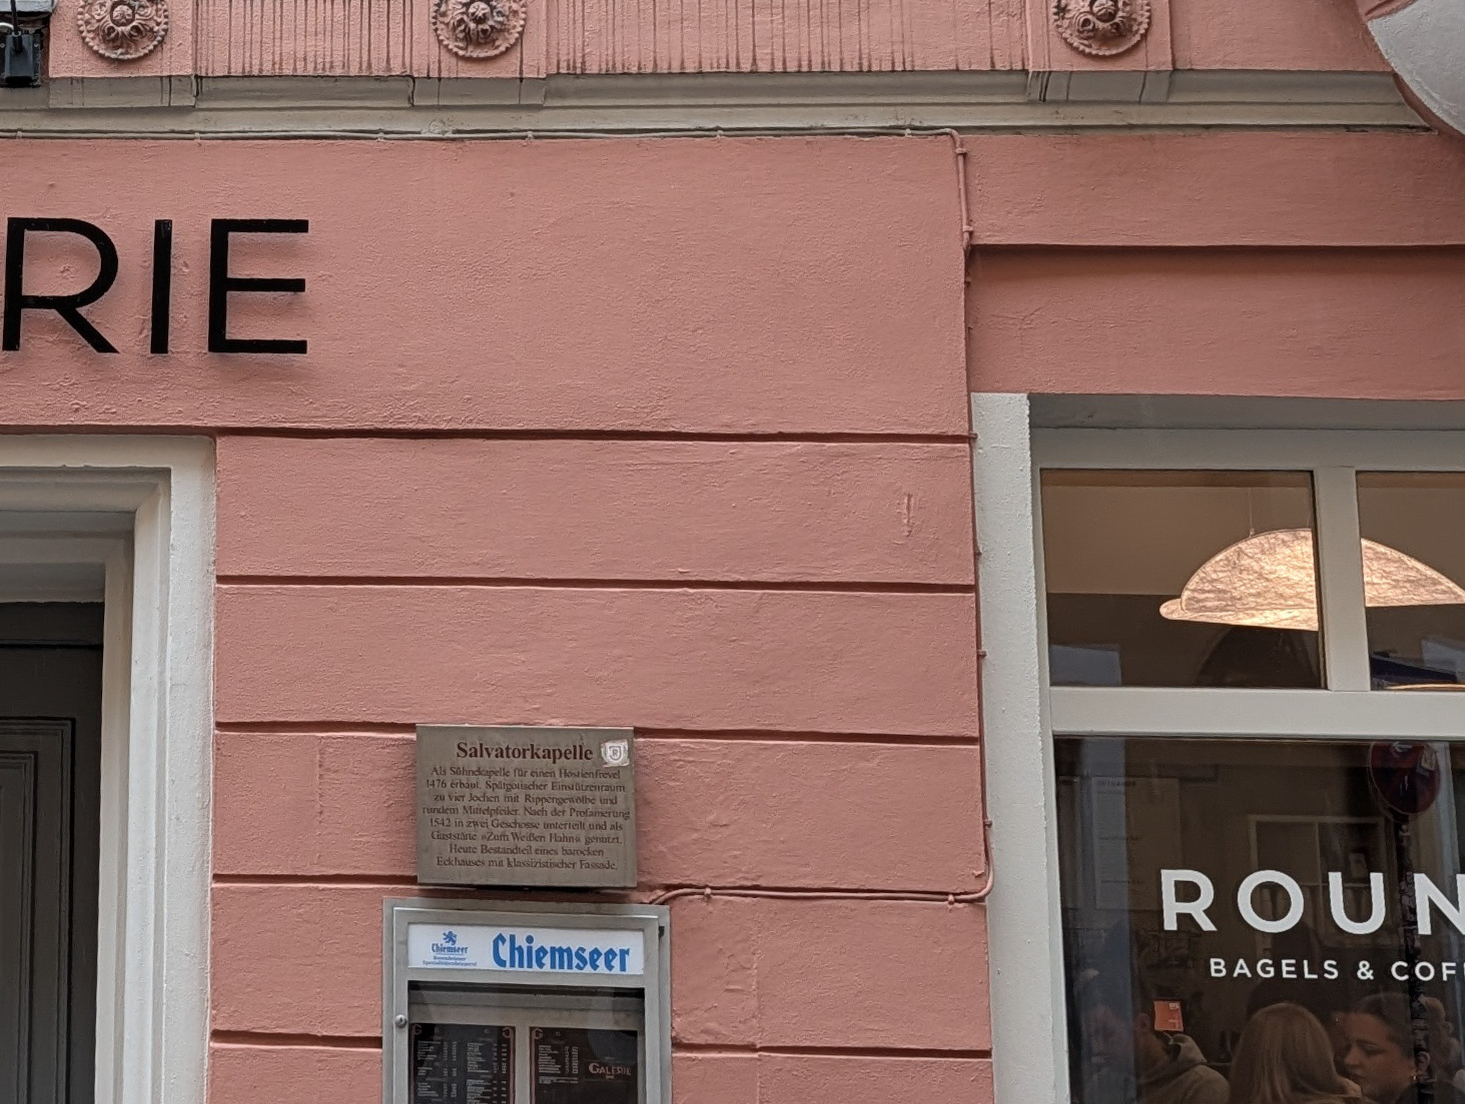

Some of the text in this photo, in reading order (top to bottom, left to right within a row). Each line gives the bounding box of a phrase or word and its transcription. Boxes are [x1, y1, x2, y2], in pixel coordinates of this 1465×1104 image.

[456, 742, 593, 764] Salvatorkapelle
[431, 766, 621, 779] Als Sühnekapelle für einen Hostienfrevel
[426, 779, 447, 788] 1476
[448, 792, 465, 802] vier
[468, 793, 500, 802] Jochen
[504, 793, 519, 802] mit
[524, 794, 595, 806] Rippengewölbe
[599, 795, 618, 805] und
[422, 805, 459, 814] rundem
[524, 806, 548, 817] Nach
[551, 807, 566, 817] der
[430, 817, 623, 831] 1542 in zwei Geschosse unterteilt und als
[431, 830, 477, 840] Gaststätte
[511, 832, 545, 842] Weißen
[449, 844, 604, 856] Heute Bestandteil eines barocken
[436, 856, 485, 867] Eckhauses
[488, 858, 503, 867] mit
[506, 858, 577, 869] klassizistischer
[1160, 868, 1465, 936] ROUN
[492, 933, 630, 972] Chiemseer
[1209, 958, 1465, 981] BAGELS & COF
